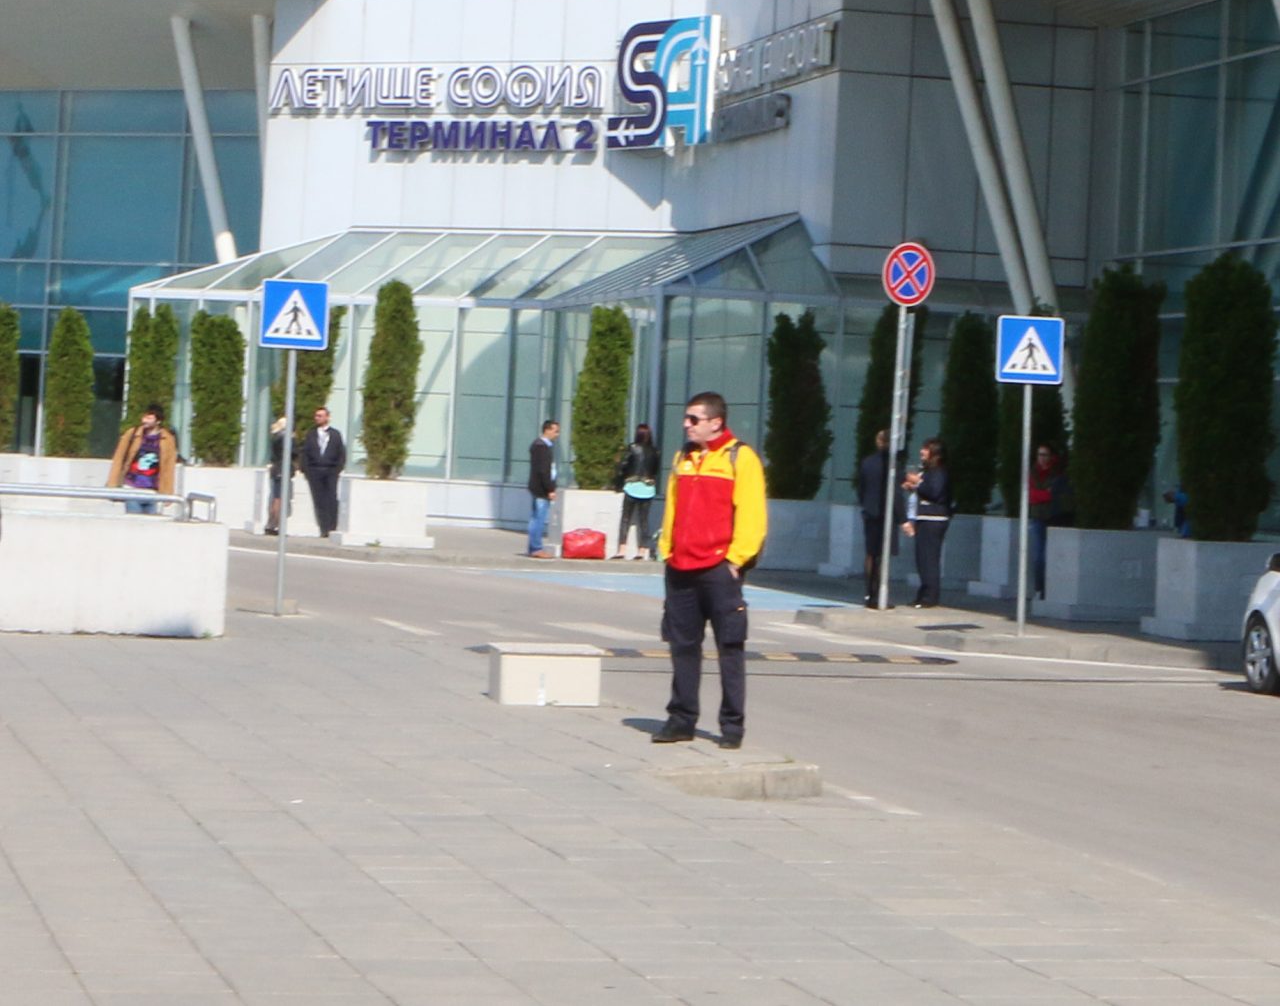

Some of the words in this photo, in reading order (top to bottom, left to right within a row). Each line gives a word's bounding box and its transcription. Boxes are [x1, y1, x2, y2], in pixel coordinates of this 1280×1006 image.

[270, 67, 435, 109] ЛЕТИЩЕ
[448, 65, 604, 108] СОФИЯ
[366, 120, 561, 150] ТЕРМИНАЛ
[574, 120, 595, 150] 2
